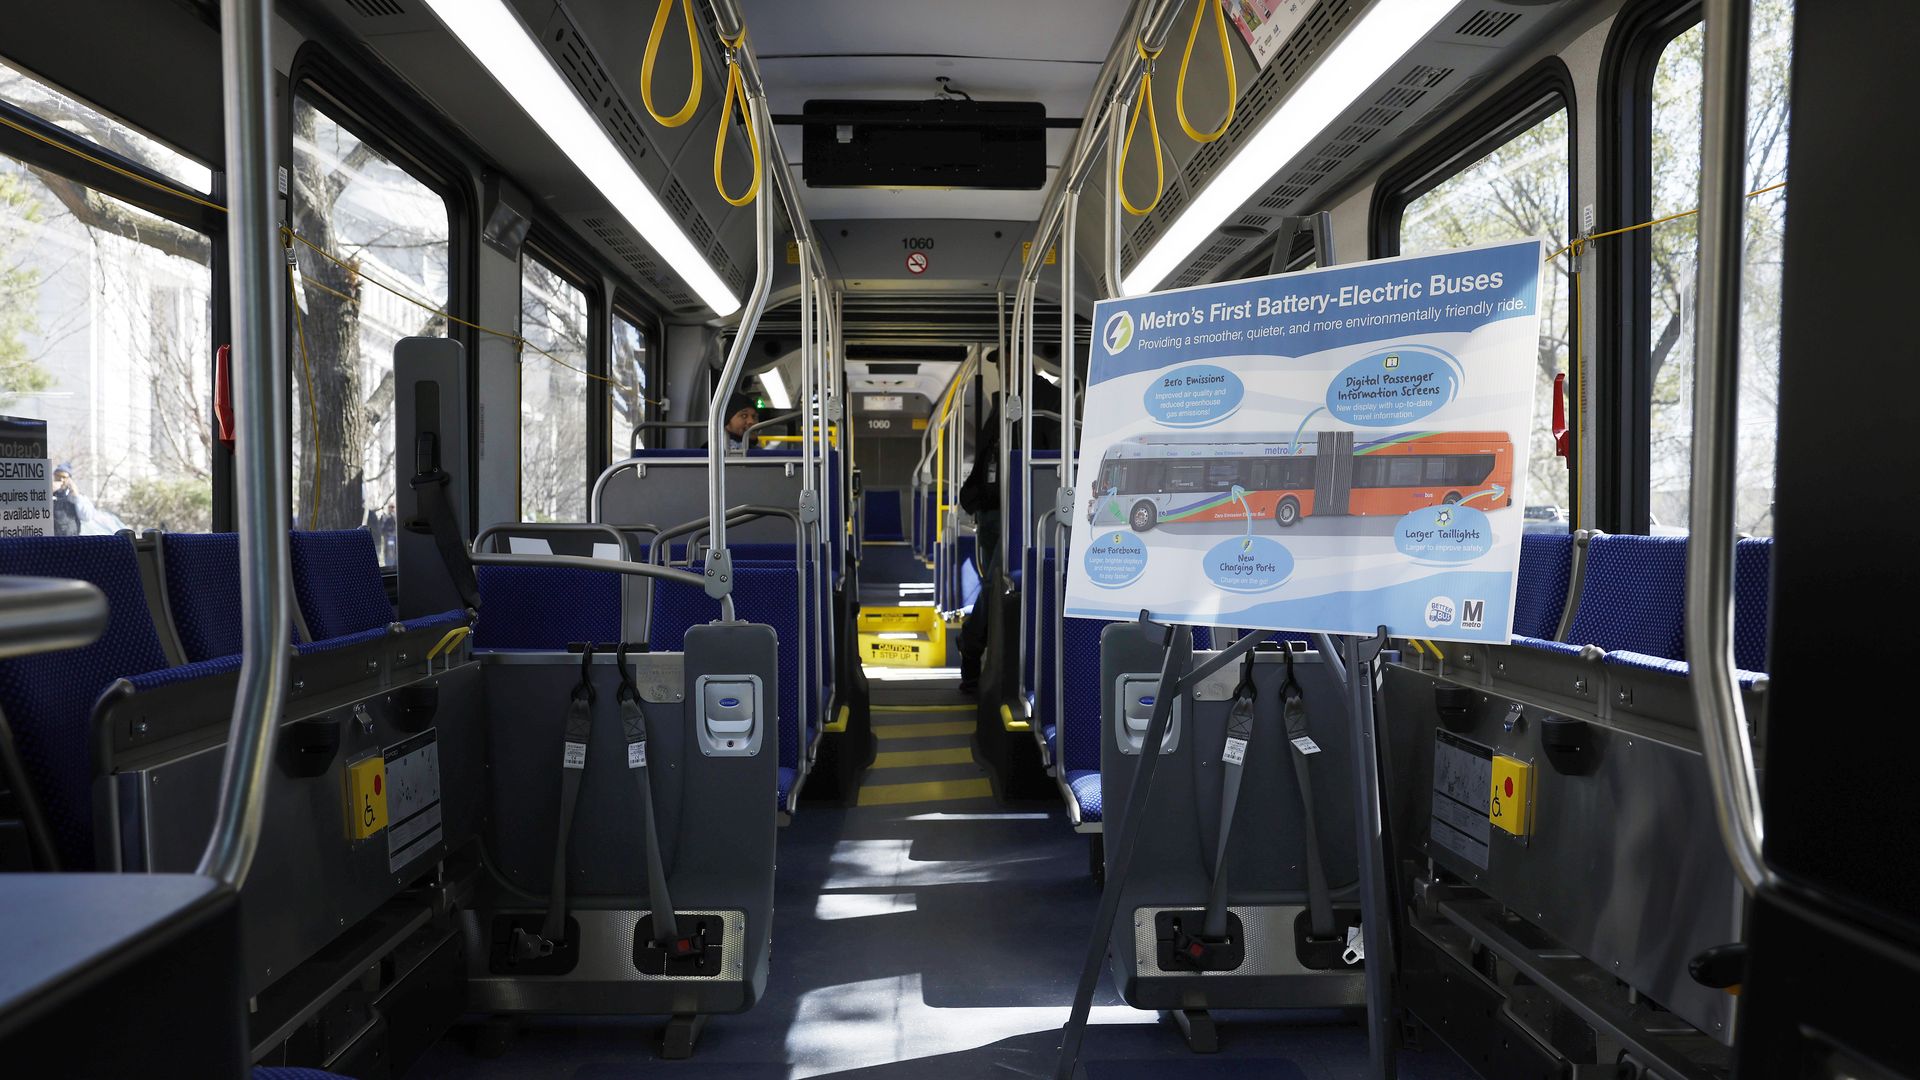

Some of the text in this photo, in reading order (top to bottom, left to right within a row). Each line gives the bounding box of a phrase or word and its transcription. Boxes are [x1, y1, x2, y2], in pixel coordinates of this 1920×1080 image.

[902, 238, 934, 250] 1060
[1139, 271, 1504, 331] Metro's First Battery-Electric Buses
[1138, 297, 1527, 350] Providing a smoother, quieter, and more environmentally friendly ride.
[1164, 374, 1225, 388] Zero Emissions
[1346, 371, 1435, 391] Digital Passenger
[1155, 391, 1183, 401] Improved
[1192, 389, 1212, 399] quality
[1338, 385, 1440, 400] Information Screens
[1160, 398, 1221, 409] reduced greenhouse
[1336, 404, 1351, 412] New
[1353, 402, 1376, 412] display
[1395, 400, 1432, 409] up-to-date
[1166, 411, 1178, 419] gas
[1353, 410, 1415, 421] travel information.
[868, 420, 890, 429] 1060
[0, 463, 44, 478] SEATING
[30, 489, 46, 501] that
[4, 507, 50, 520] available to
[1405, 530, 1480, 543] Larger Taillights
[1405, 544, 1425, 552] Larger
[1435, 544, 1460, 552] improve
[1462, 544, 1483, 552] safety.
[1238, 554, 1254, 562] New
[1220, 563, 1276, 575] Charging Ports
[1432, 602, 1453, 613] BETTER
[1463, 600, 1484, 621] M
[1437, 611, 1451, 621] BUS
[879, 644, 912, 653] CAUTION
[880, 651, 911, 660] STEP UP
